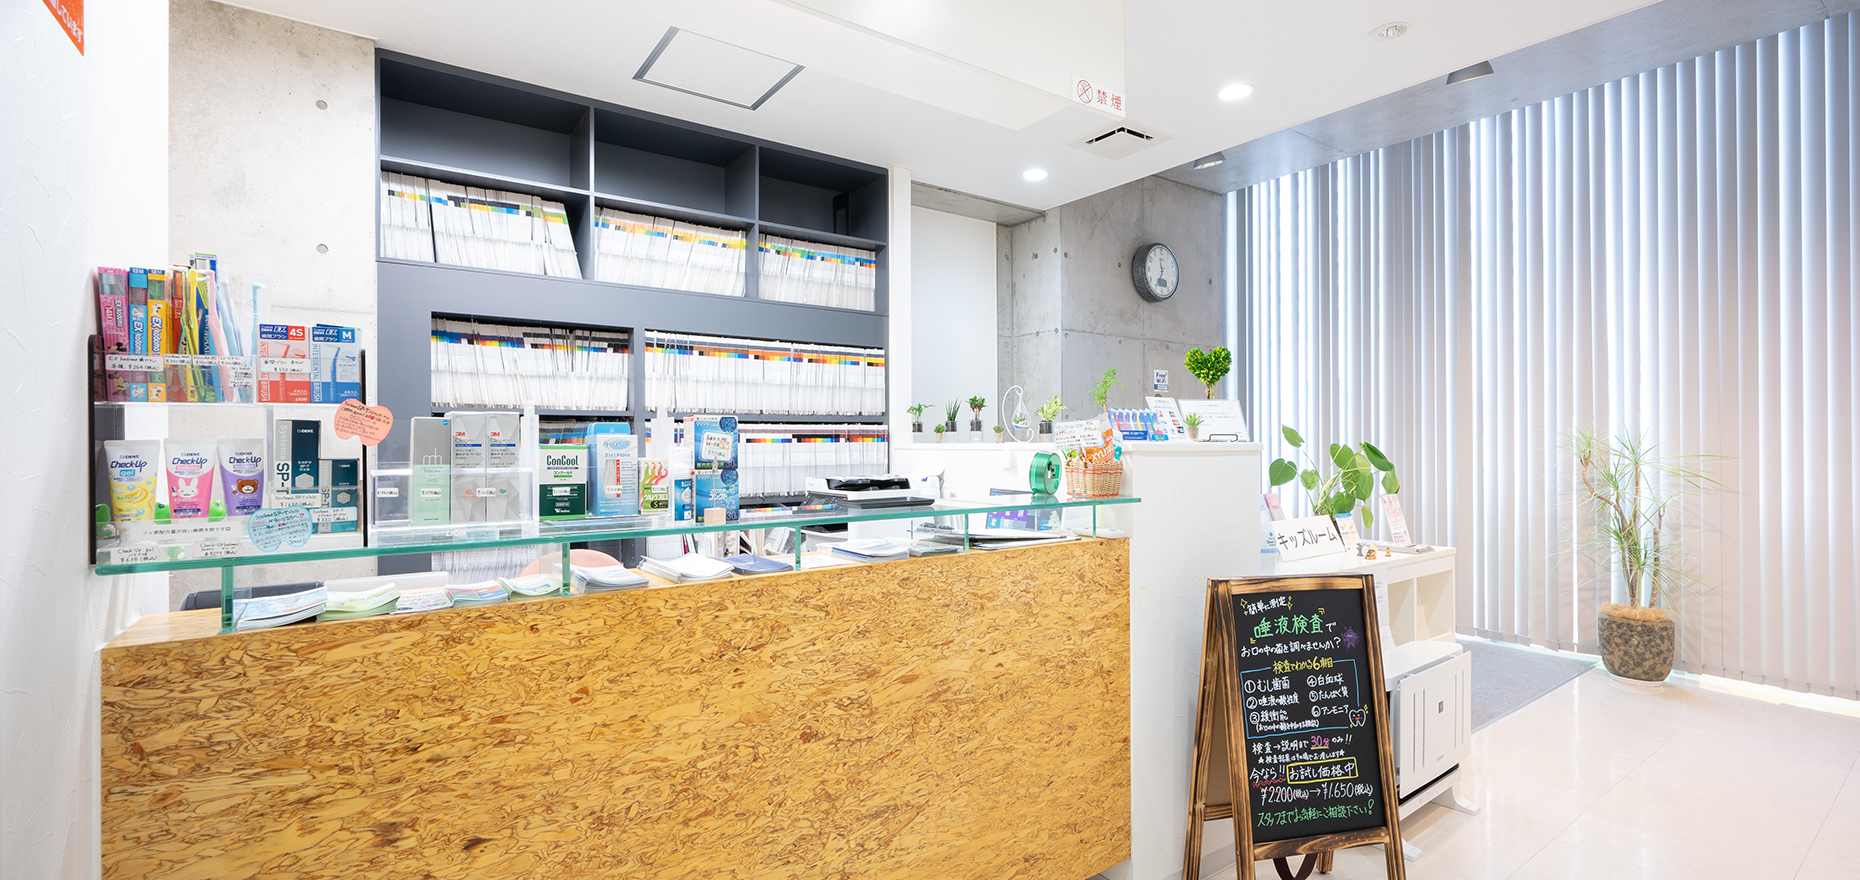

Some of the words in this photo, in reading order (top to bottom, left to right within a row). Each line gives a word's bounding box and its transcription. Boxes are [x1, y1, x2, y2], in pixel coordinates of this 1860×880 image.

[1096, 88, 1122, 111] 禁煙
[133, 321, 144, 333] EX
[151, 317, 163, 329] EX
[290, 329, 303, 337] 4S
[342, 331, 352, 340] M
[280, 424, 288, 460] Systema
[547, 455, 579, 466] ConCool
[653, 500, 658, 508] S
[446, 529, 467, 537] LION
[1278, 528, 1338, 551] キッズルーム
[1247, 596, 1288, 615] 簡単に測定
[1253, 613, 1337, 639] 唾液検査で
[1272, 656, 1333, 674] 検査でわかる6項目
[1289, 762, 1355, 780] お試し価格中
